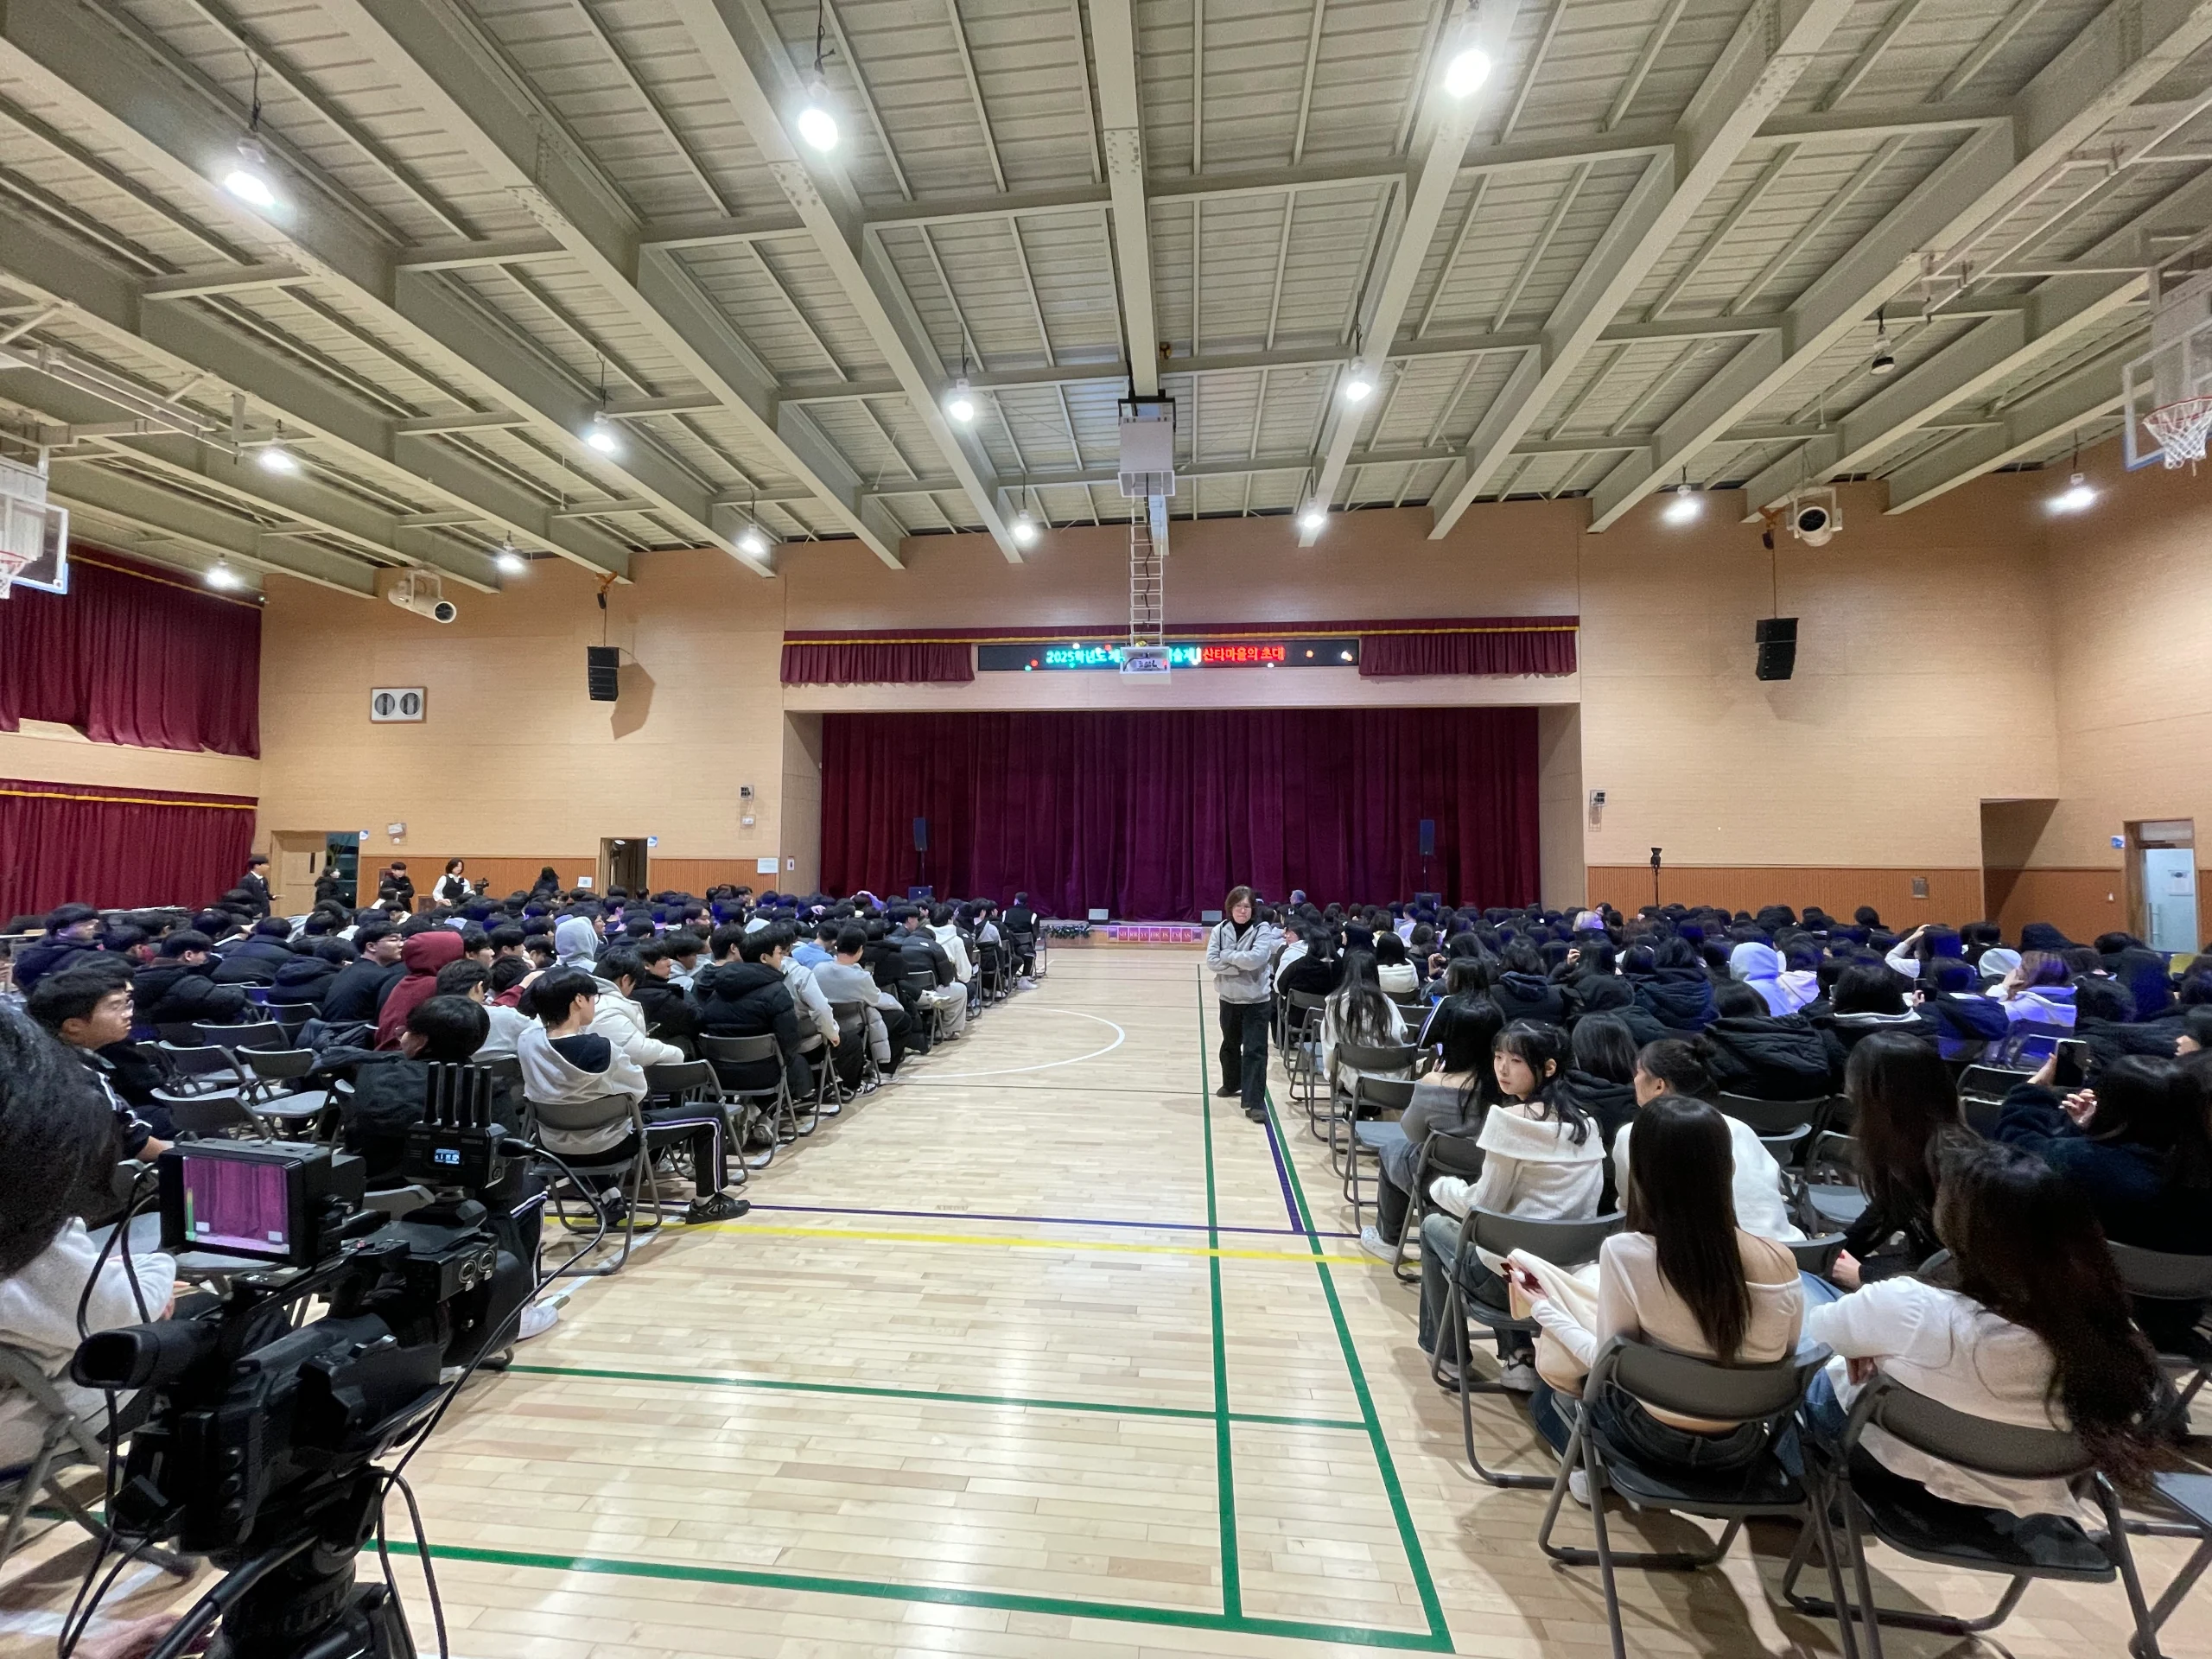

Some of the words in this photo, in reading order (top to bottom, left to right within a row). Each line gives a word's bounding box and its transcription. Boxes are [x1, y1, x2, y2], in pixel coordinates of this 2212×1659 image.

[1046, 649, 1107, 664] 2025학년도
[1203, 646, 1258, 662] 산타마을의
[1261, 645, 1285, 661] 초대
